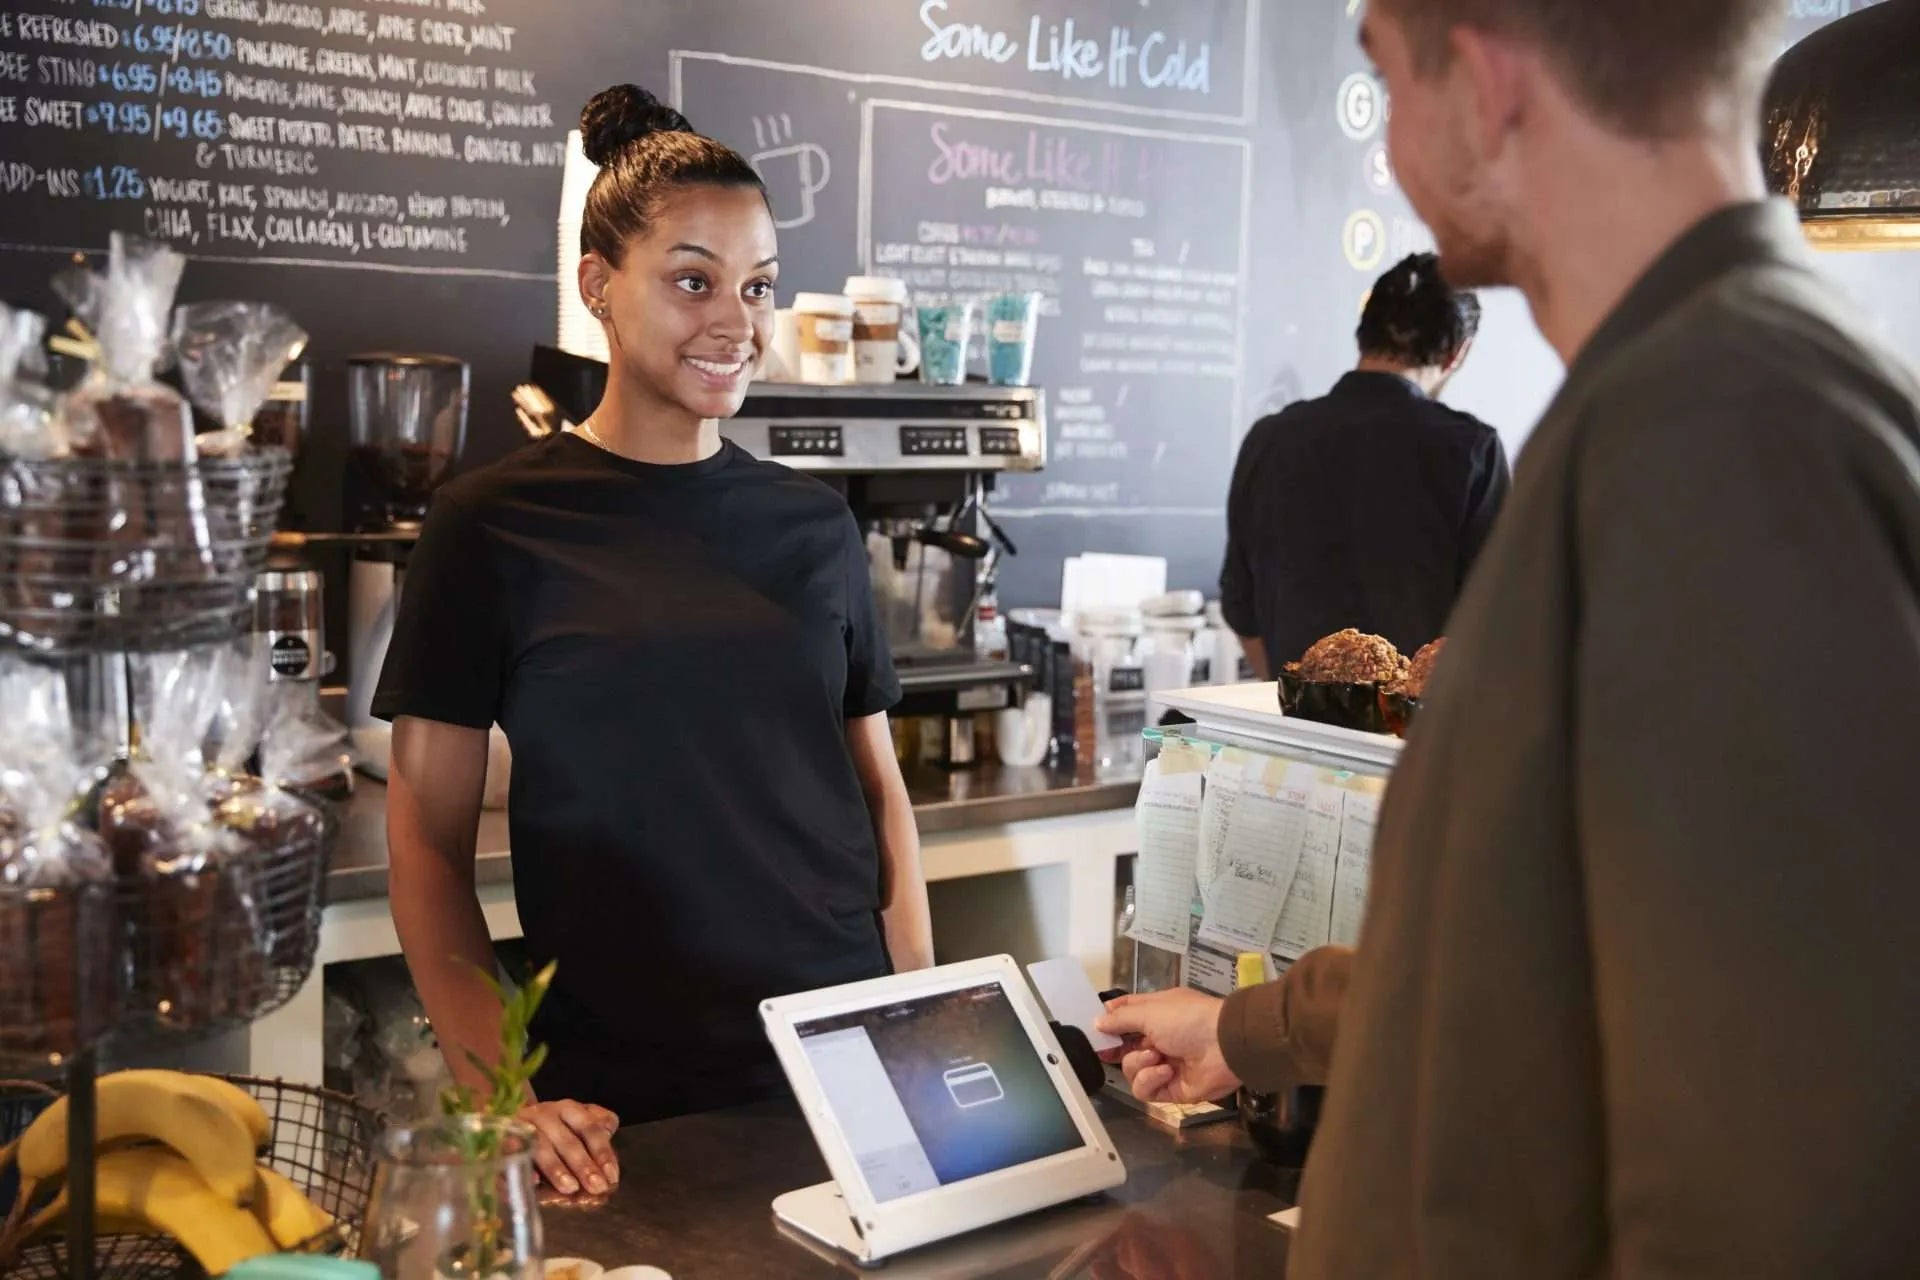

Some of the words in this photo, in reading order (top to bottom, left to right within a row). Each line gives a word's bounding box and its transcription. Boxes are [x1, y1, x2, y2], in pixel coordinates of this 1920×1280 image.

[17, 13, 119, 49] REFRESHED
[919, 0, 1018, 62] Some
[1027, 14, 1103, 79] Like
[1138, 31, 1211, 94] Cold
[37, 54, 97, 88] STING
[24, 96, 84, 131] SWEET
[228, 112, 276, 142] SWEET
[195, 142, 217, 169] &
[928, 122, 1024, 185] Some
[1026, 130, 1094, 190] Like
